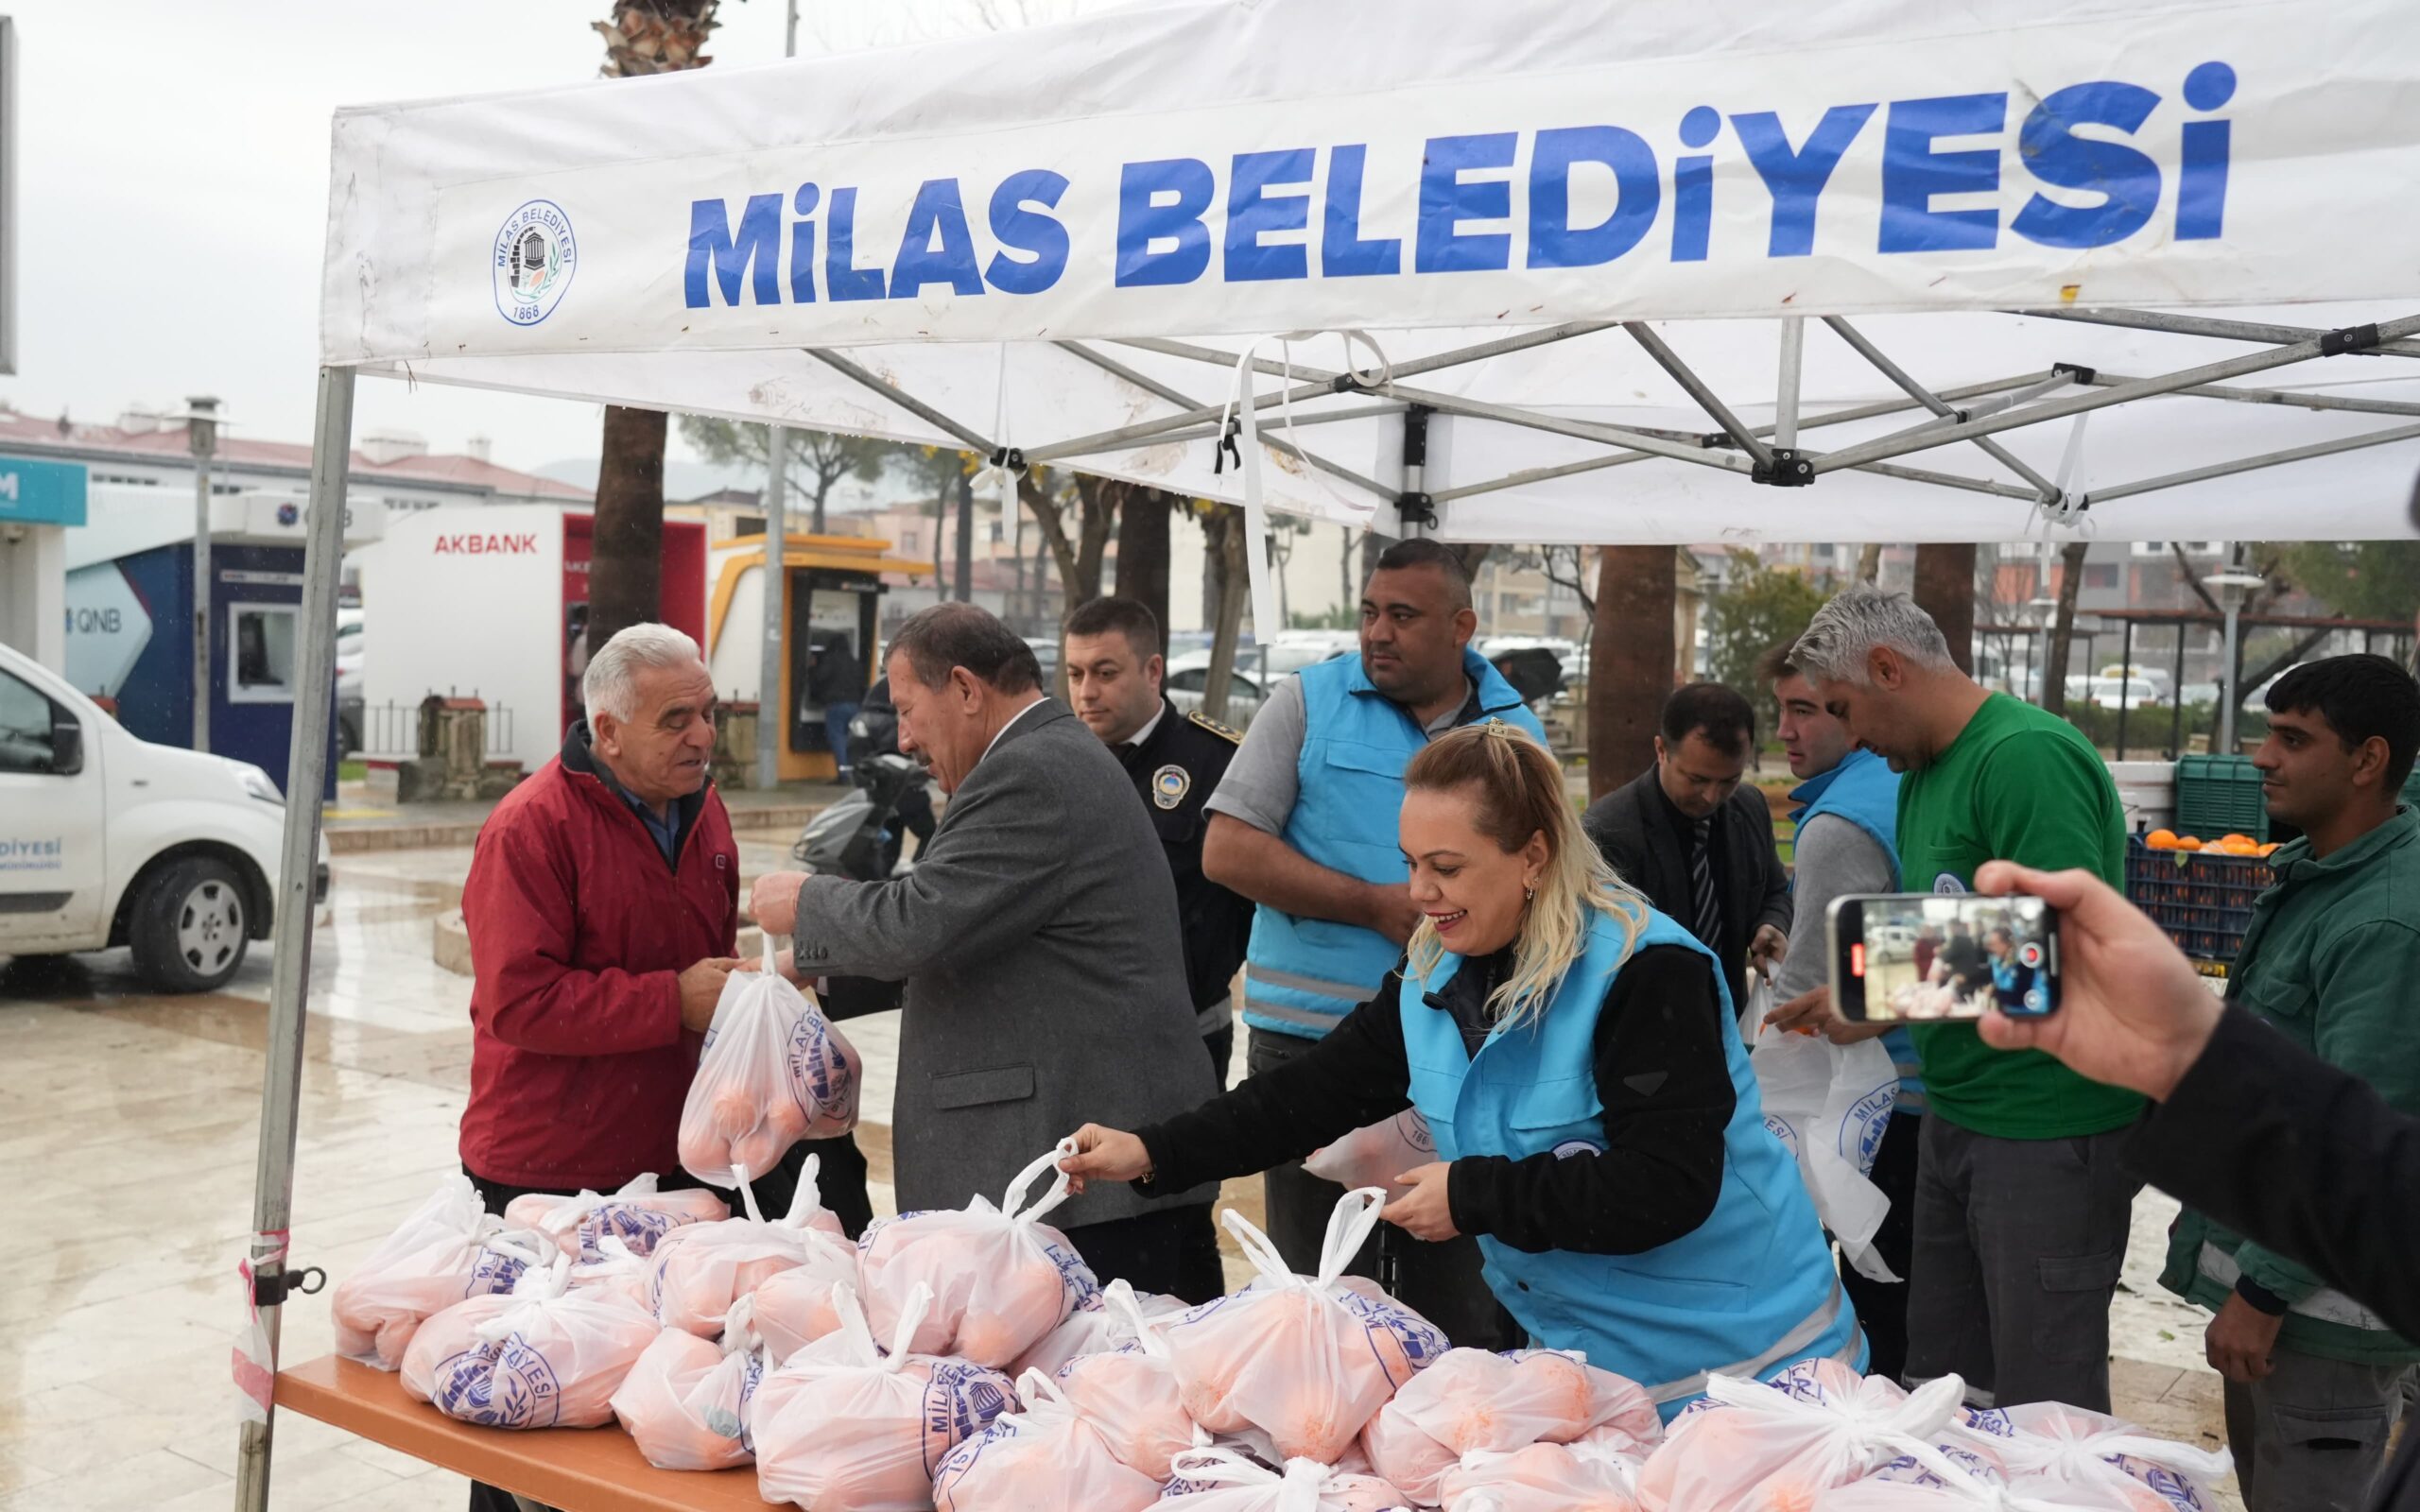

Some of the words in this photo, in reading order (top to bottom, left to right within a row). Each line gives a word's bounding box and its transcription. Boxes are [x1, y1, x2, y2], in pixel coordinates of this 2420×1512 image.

[497, 220, 519, 267] MİLAS
[522, 208, 574, 264] BELEDİYESİ
[513, 304, 539, 319] 1868
[435, 534, 537, 554] AKBANK
[78, 608, 122, 634] QNB
[1412, 1130, 1429, 1145] 186
